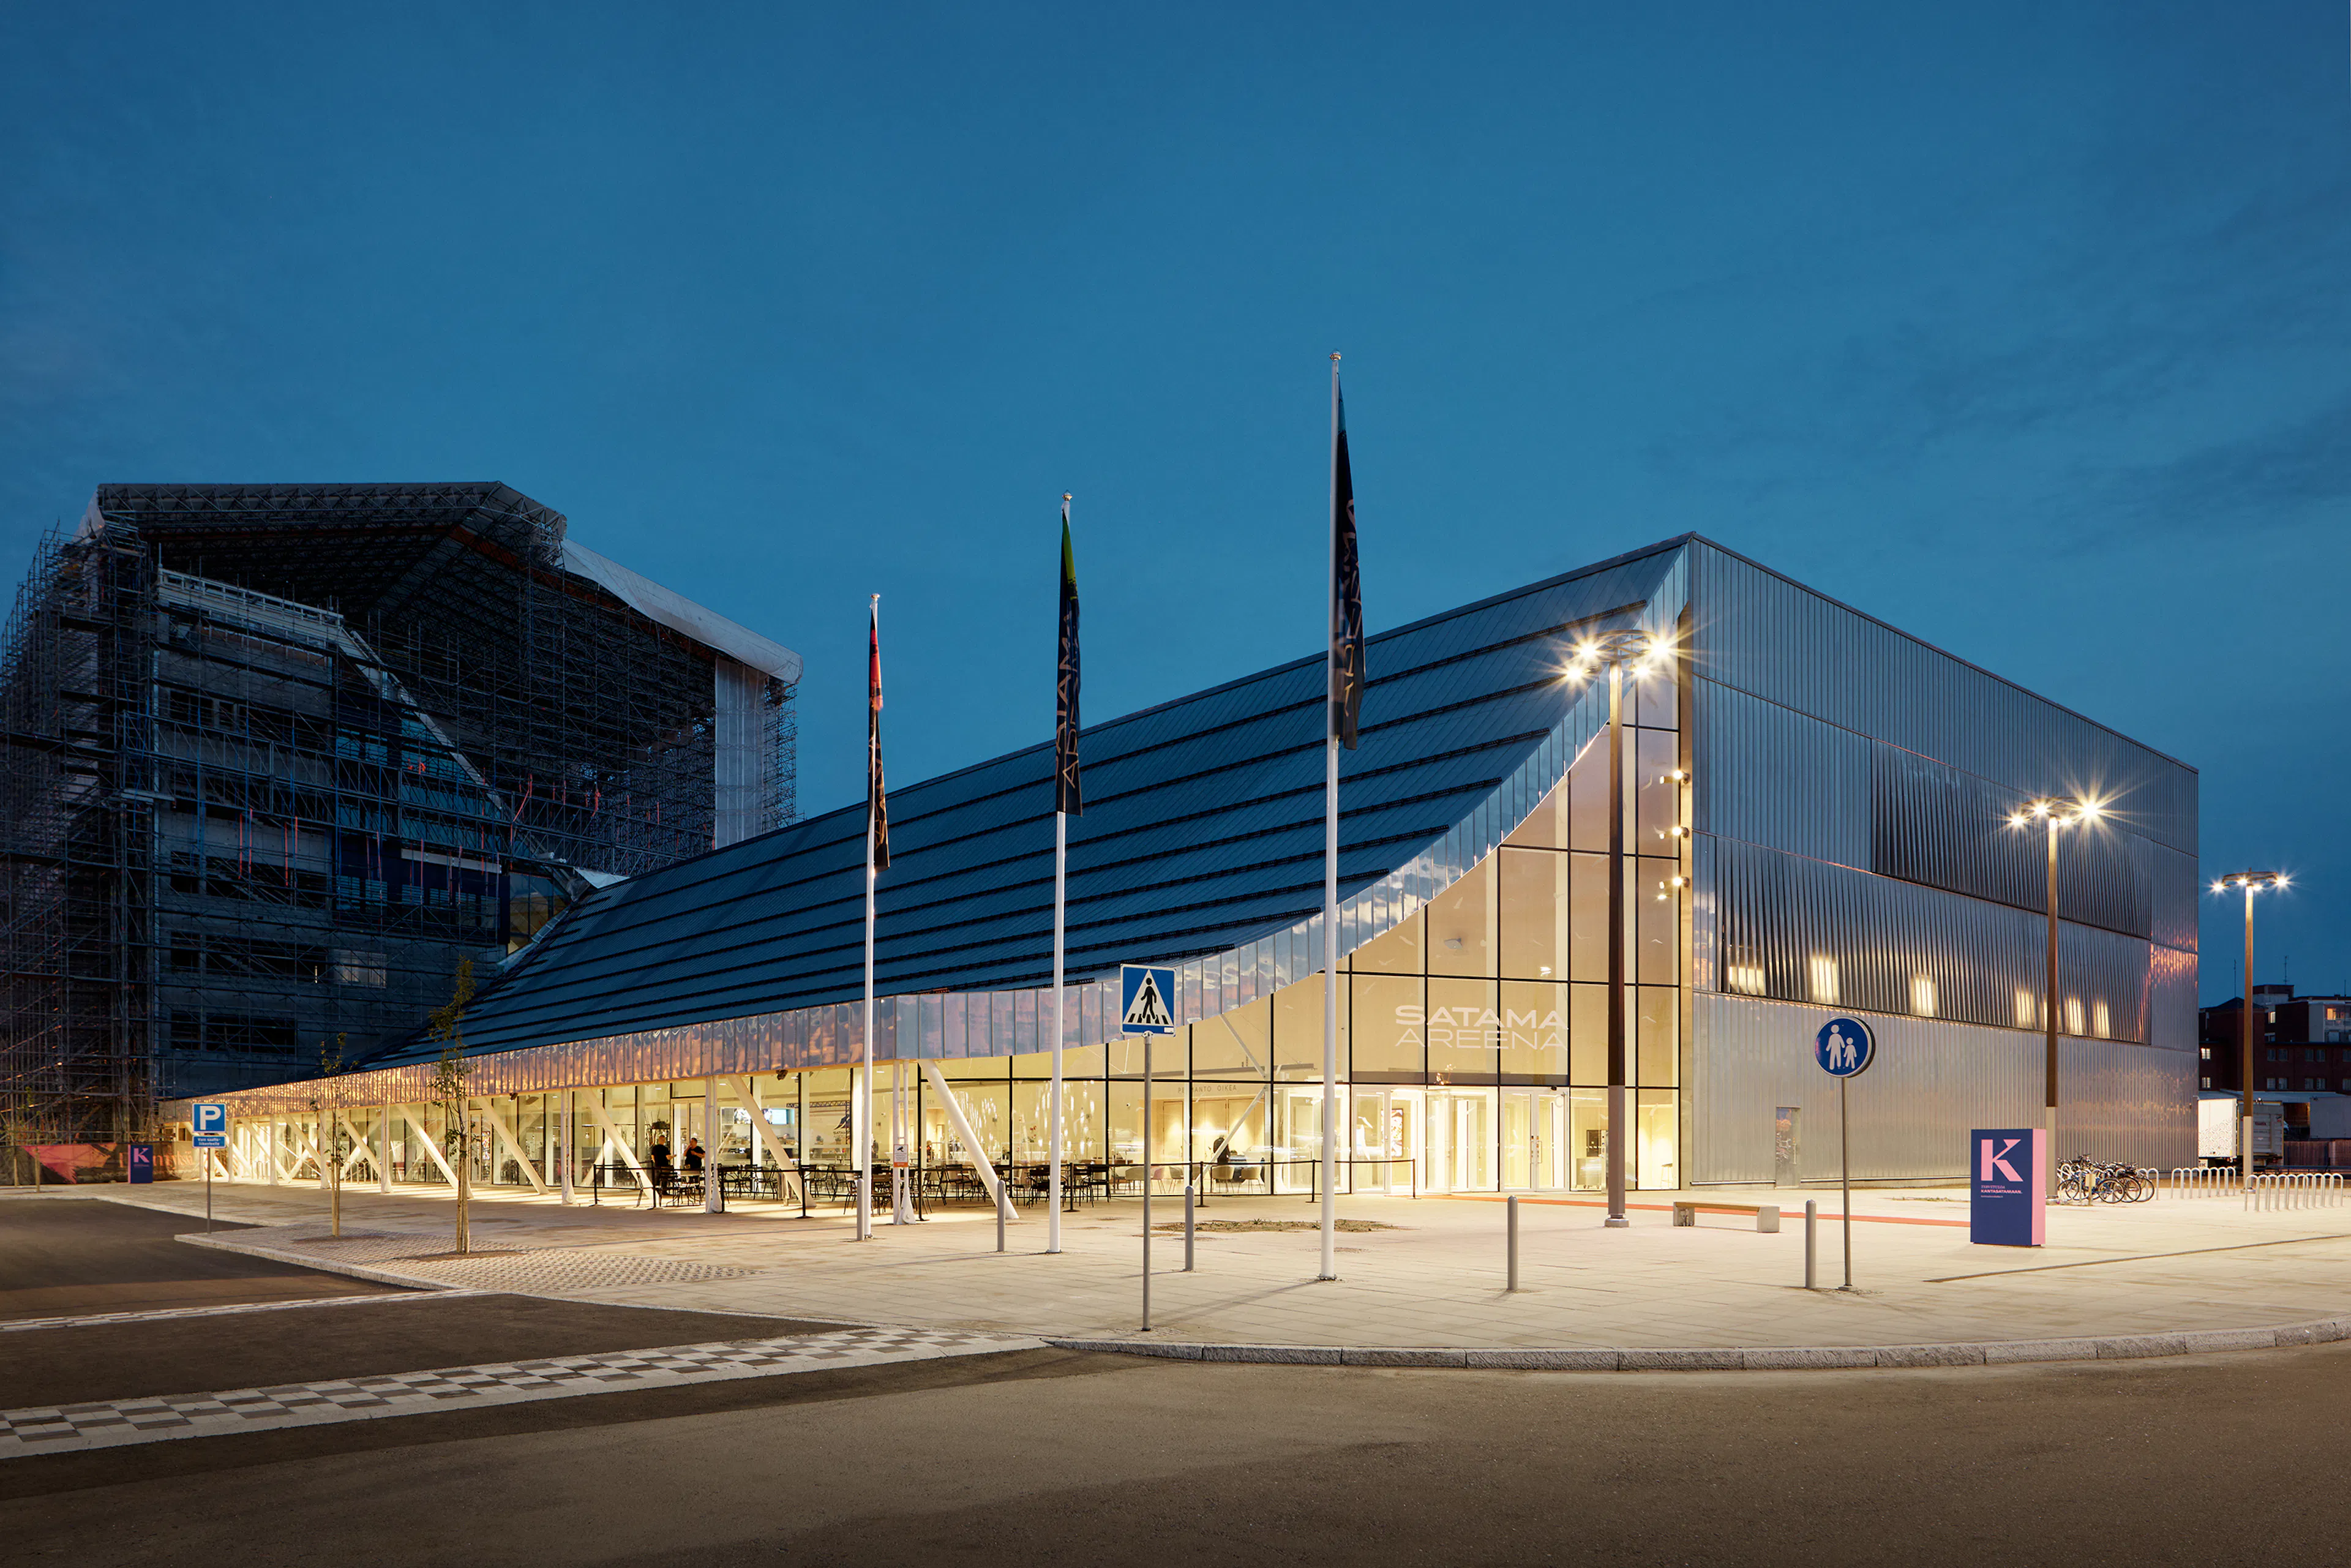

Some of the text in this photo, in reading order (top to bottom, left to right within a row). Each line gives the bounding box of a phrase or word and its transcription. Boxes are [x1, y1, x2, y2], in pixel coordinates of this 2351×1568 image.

[1395, 1005, 1569, 1030] SATAMA
[1395, 1028, 1568, 1051] AREENA
[200, 1106, 222, 1130] P
[133, 1147, 150, 1163] K
[1981, 1139, 2023, 1182] K
